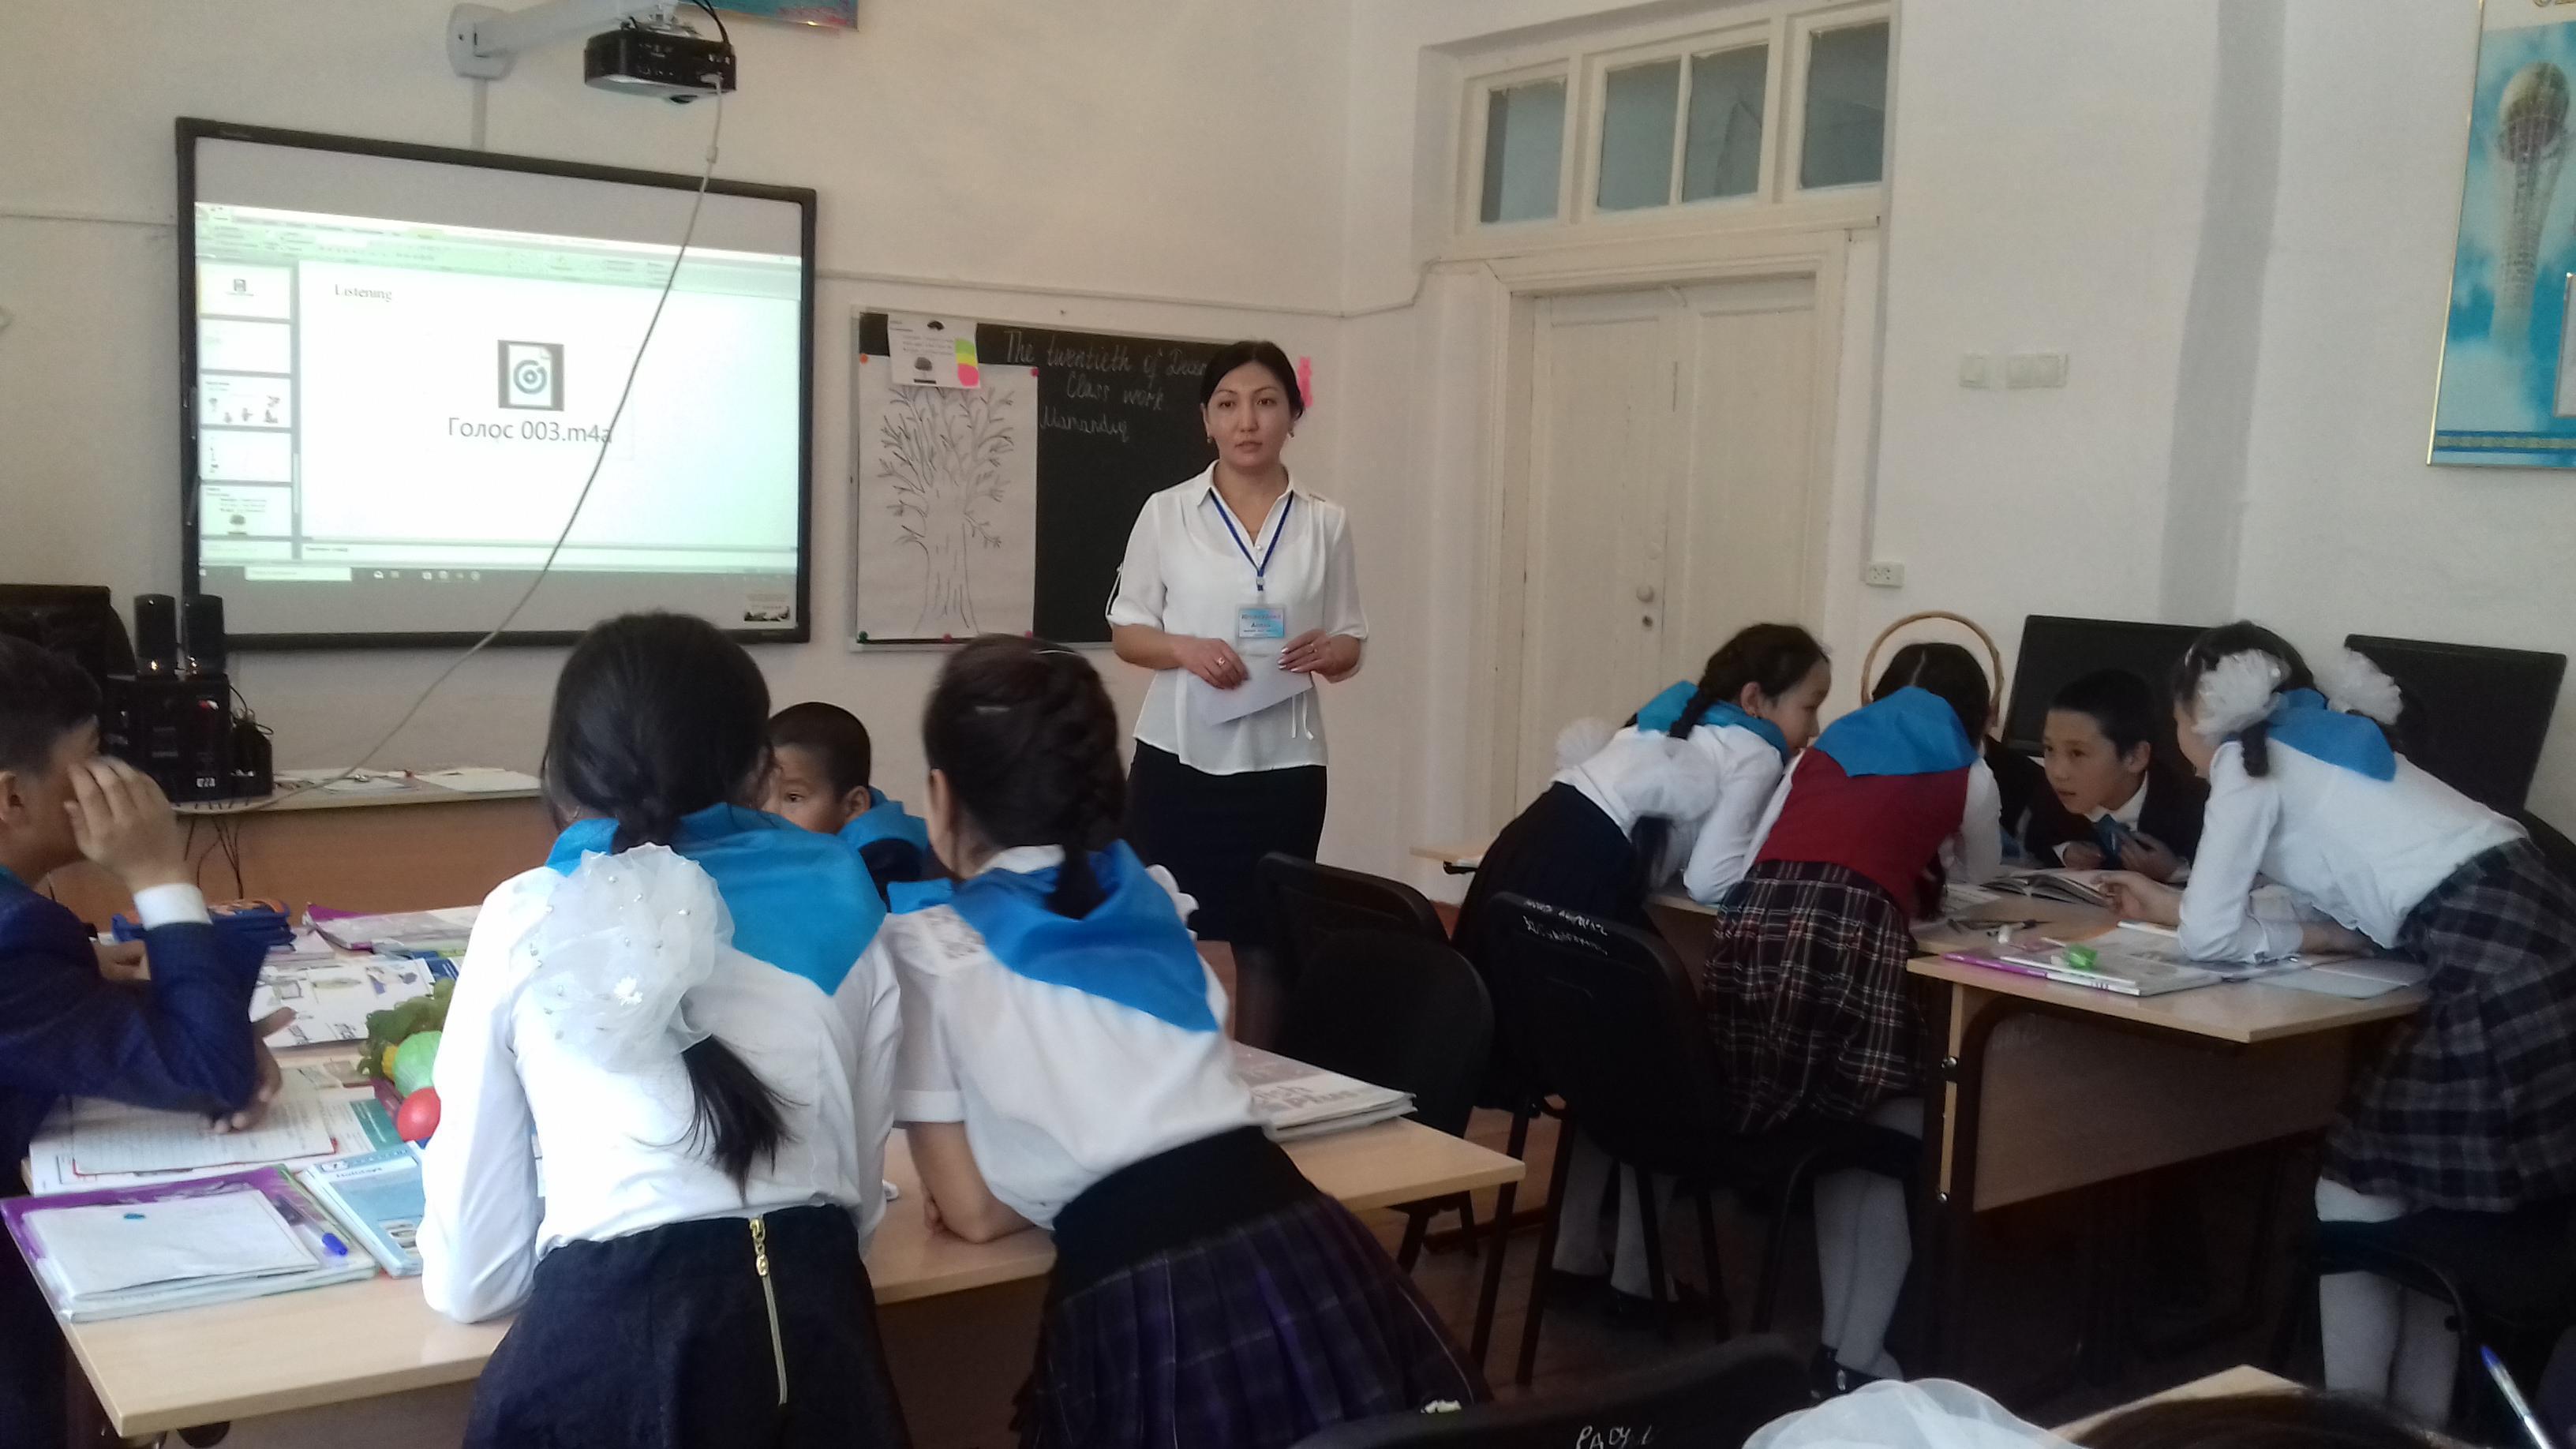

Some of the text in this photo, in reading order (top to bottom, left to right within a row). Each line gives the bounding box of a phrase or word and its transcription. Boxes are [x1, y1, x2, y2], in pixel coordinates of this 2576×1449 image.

[335, 283, 392, 303] Listening
[1003, 330, 1035, 364] The
[1046, 334, 1133, 373] twentieth
[1066, 370, 1111, 403] Class
[448, 417, 613, 444] Голос 003.m4a
